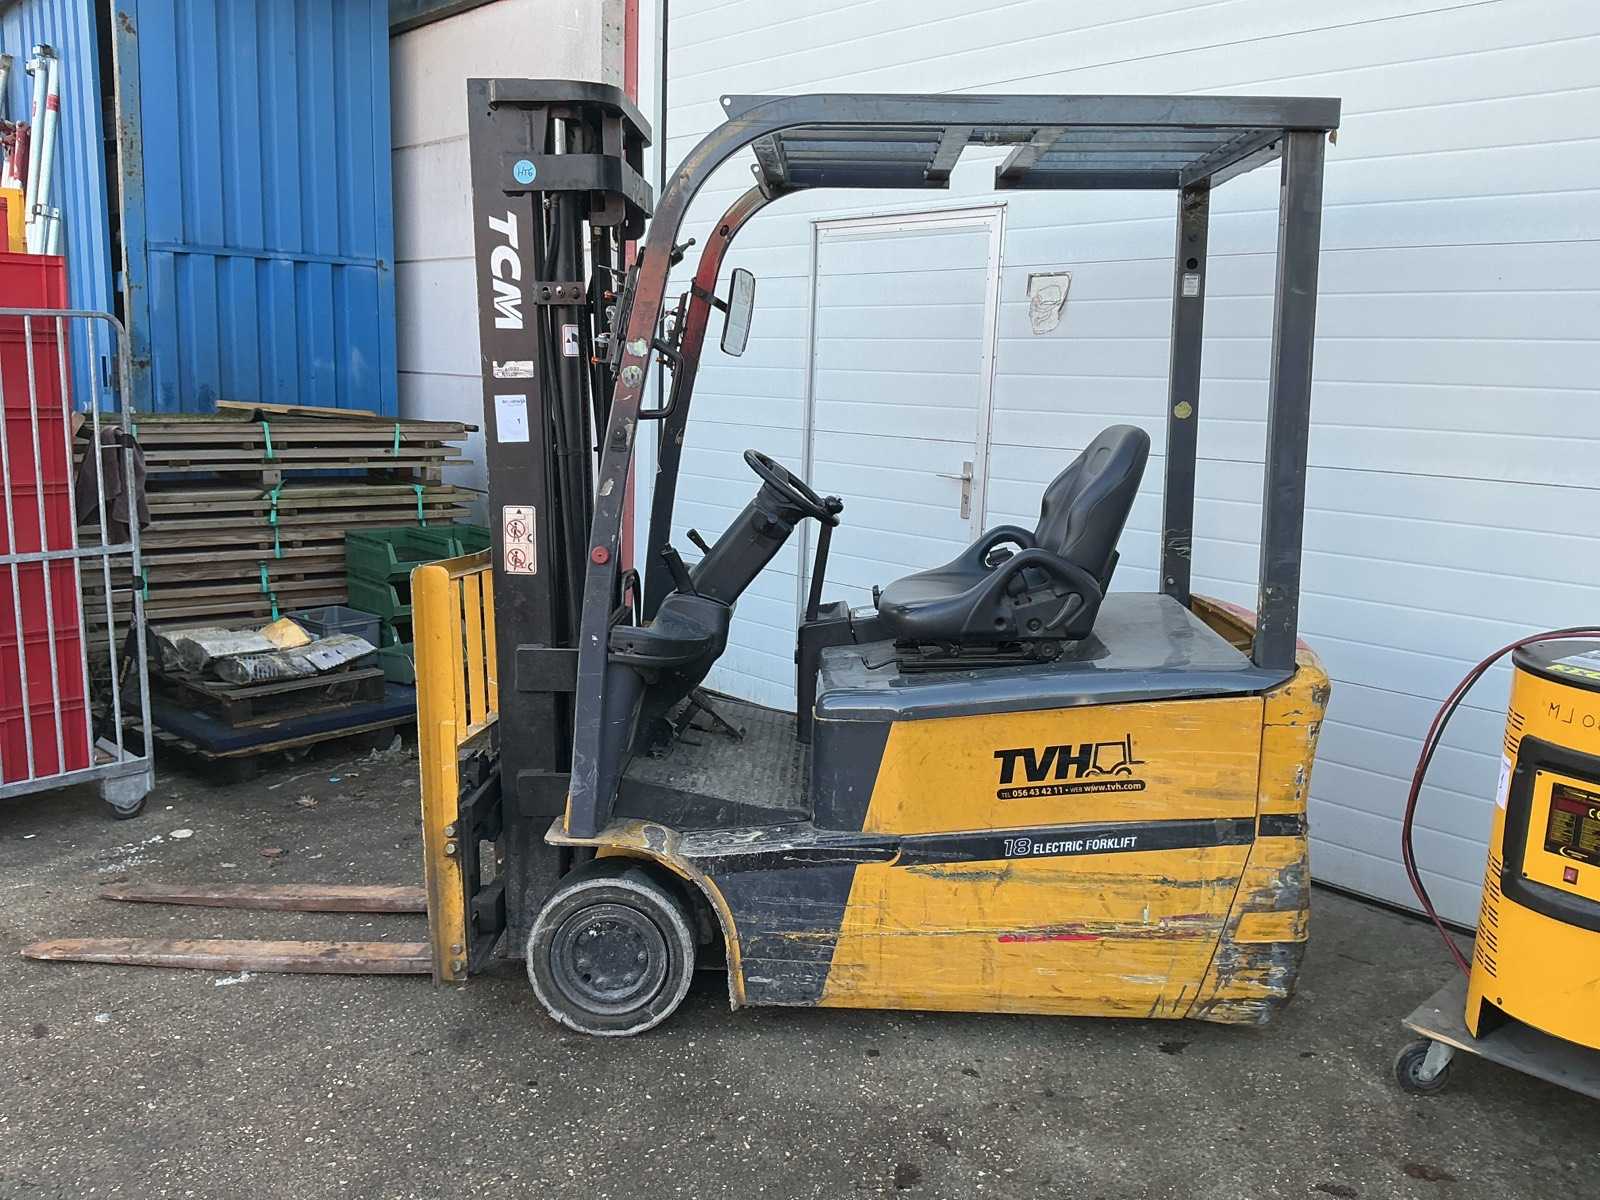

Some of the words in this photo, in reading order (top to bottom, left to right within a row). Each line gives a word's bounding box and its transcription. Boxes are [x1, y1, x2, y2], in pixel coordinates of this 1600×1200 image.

[488, 210, 524, 329] TCM
[994, 743, 1094, 784] TVH
[1012, 789, 1028, 798] 056
[1029, 788, 1040, 796] 43
[1041, 787, 1052, 795] 42
[1053, 786, 1064, 794] 11
[1083, 782, 1142, 792] www.tvh.com
[1004, 837, 1032, 857] 18
[1033, 840, 1084, 854] ELECTRIC
[1086, 836, 1137, 851] FORKLIFT
